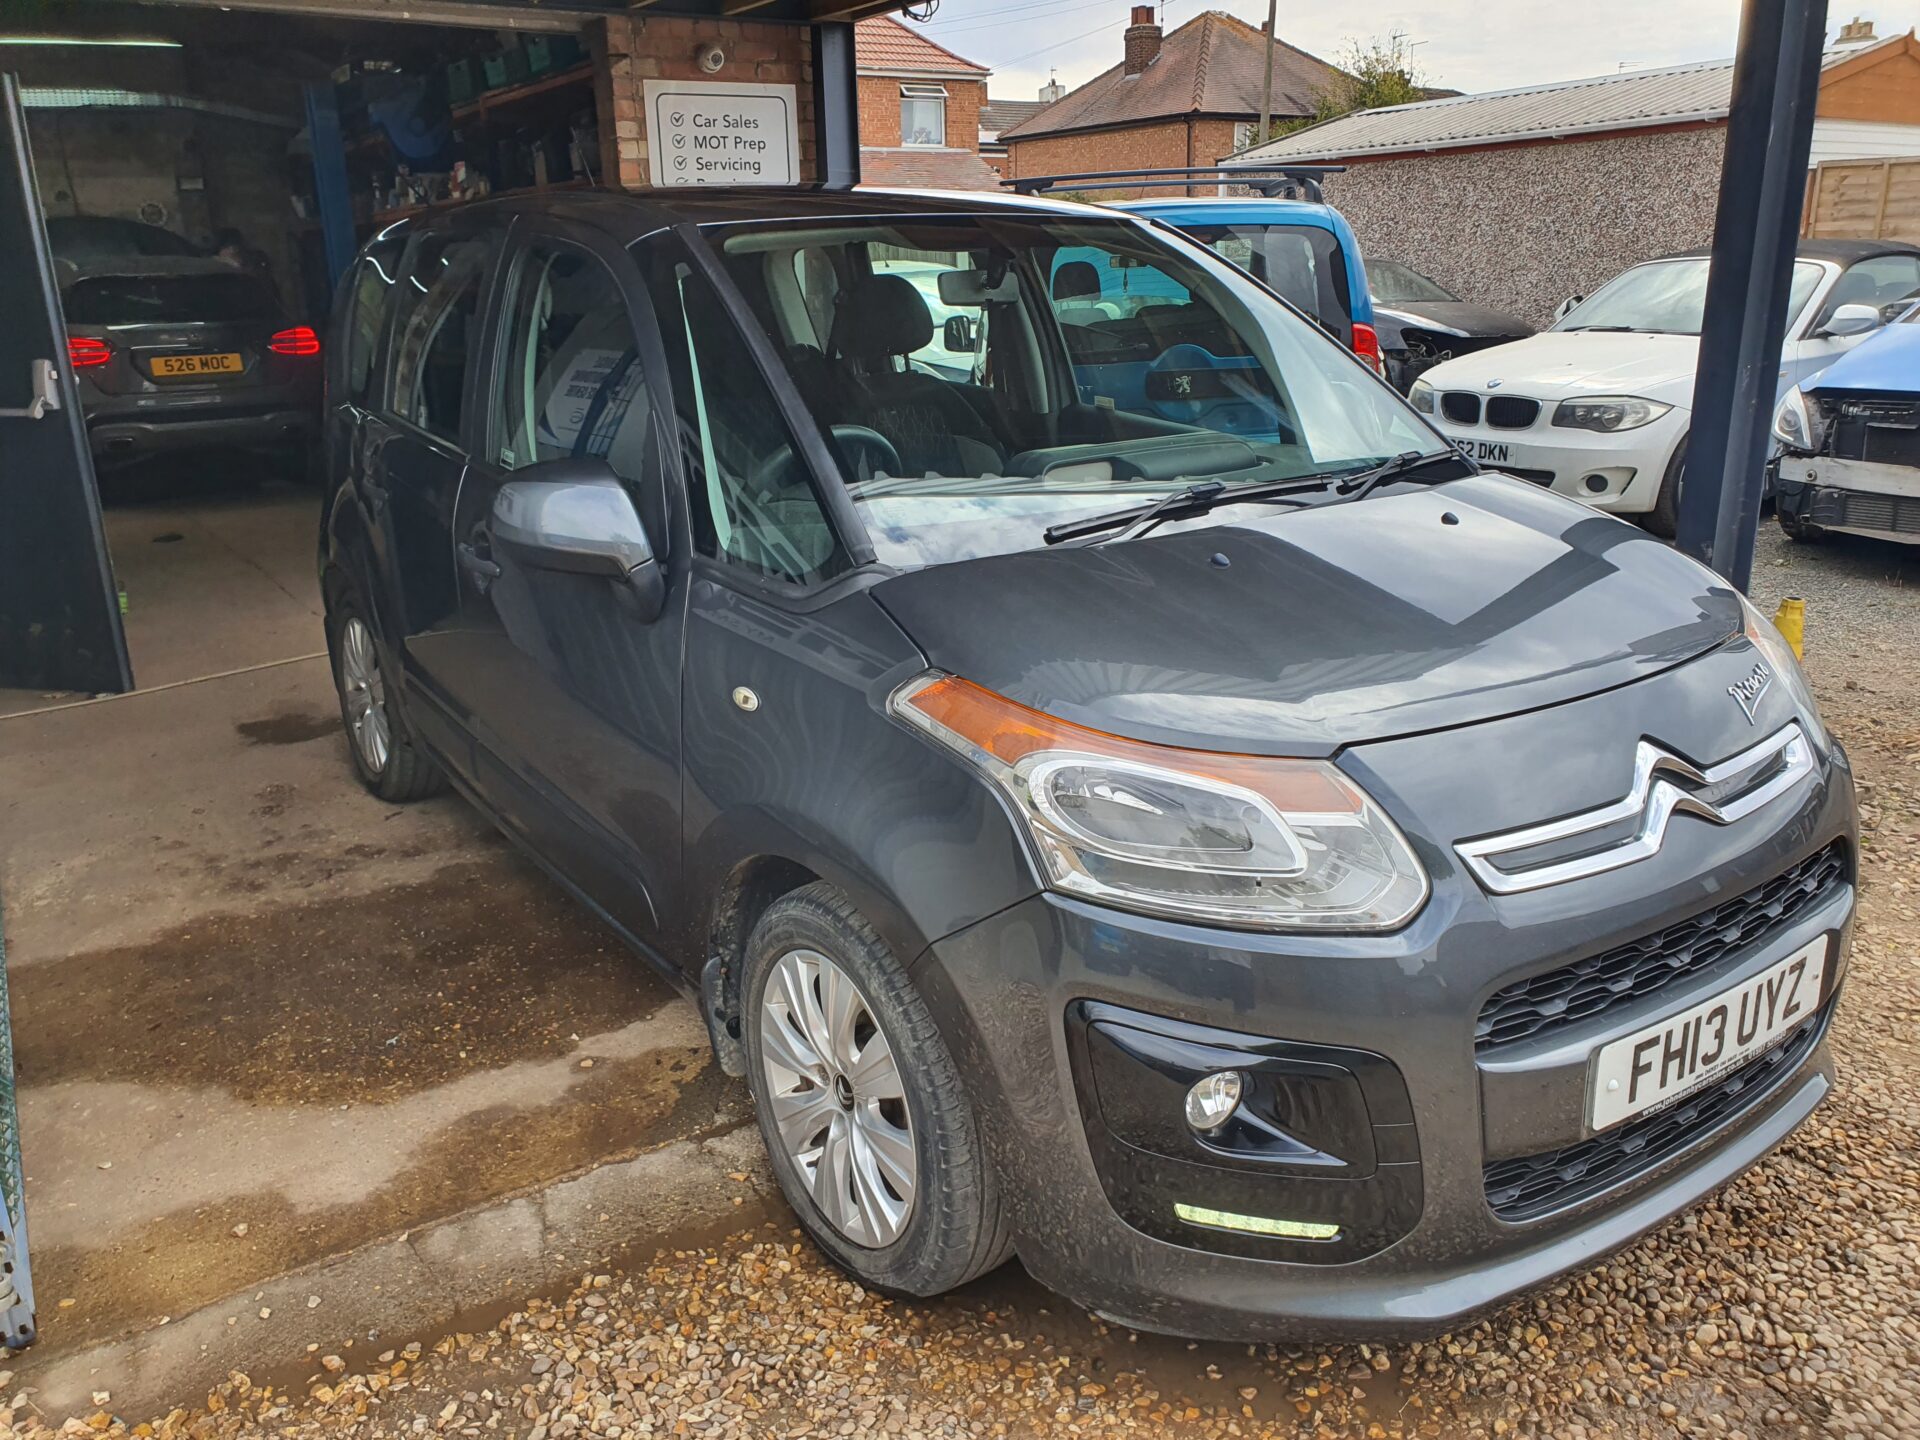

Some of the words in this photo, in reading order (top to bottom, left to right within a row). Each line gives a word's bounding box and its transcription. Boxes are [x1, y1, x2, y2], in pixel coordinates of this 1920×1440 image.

[692, 113, 718, 128] Car
[722, 114, 759, 129] Sales
[694, 135, 729, 150] MOT
[734, 136, 766, 154] Prep
[696, 156, 761, 175] Servicing
[164, 357, 196, 373] 526
[200, 355, 230, 370] MOC
[1478, 442, 1509, 462] DKN
[1628, 1004, 1729, 1105] FH13
[1736, 956, 1808, 1047] UYZ
